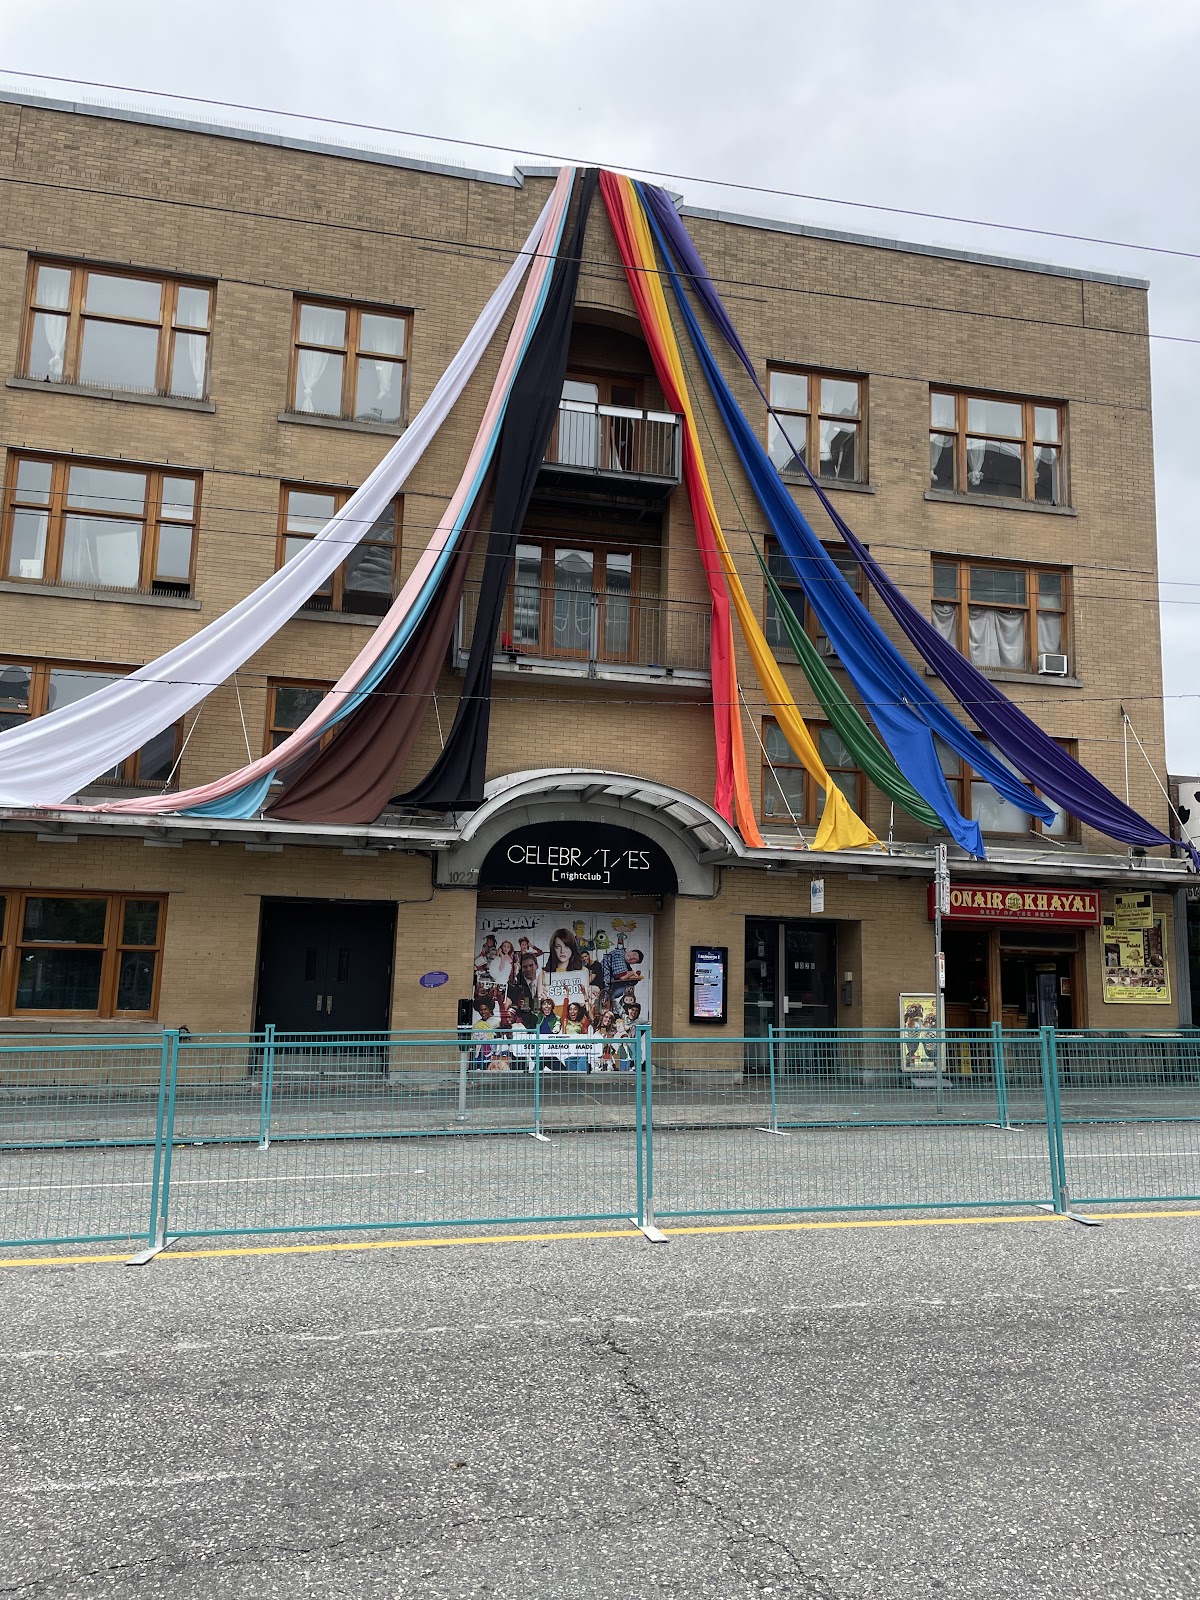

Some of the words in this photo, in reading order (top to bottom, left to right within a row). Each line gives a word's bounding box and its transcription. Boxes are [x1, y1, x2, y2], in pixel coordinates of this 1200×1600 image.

[450, 871, 474, 883] 1022
[950, 890, 1004, 909] ONAIR
[1023, 893, 1095, 912] KHAYAL
[478, 916, 542, 932] TUESDAYS
